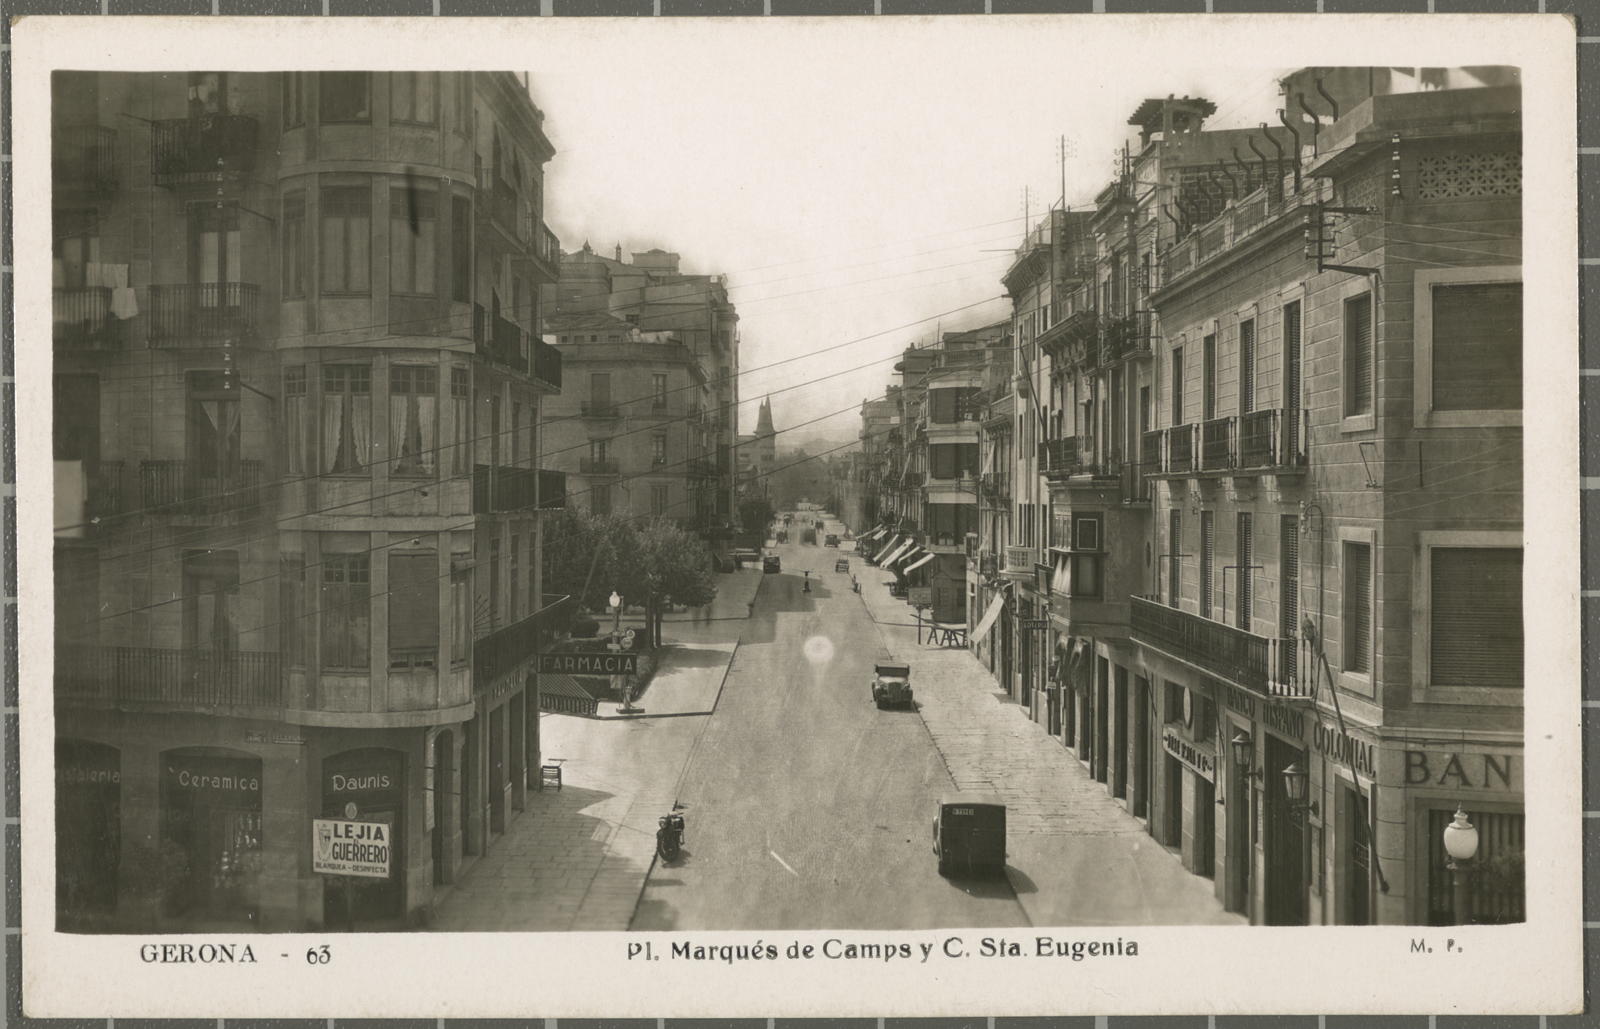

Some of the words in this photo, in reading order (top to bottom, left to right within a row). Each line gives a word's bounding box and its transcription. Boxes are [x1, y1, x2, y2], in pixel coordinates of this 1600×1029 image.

[543, 656, 634, 672] FARMACIA
[1262, 702, 1305, 741] HISPANO
[1313, 720, 1377, 779] COLONIAL
[178, 770, 259, 791] Ceramica
[332, 773, 390, 792] Daunis
[333, 823, 385, 842] LEJIA
[332, 841, 388, 864] GUERRERO
